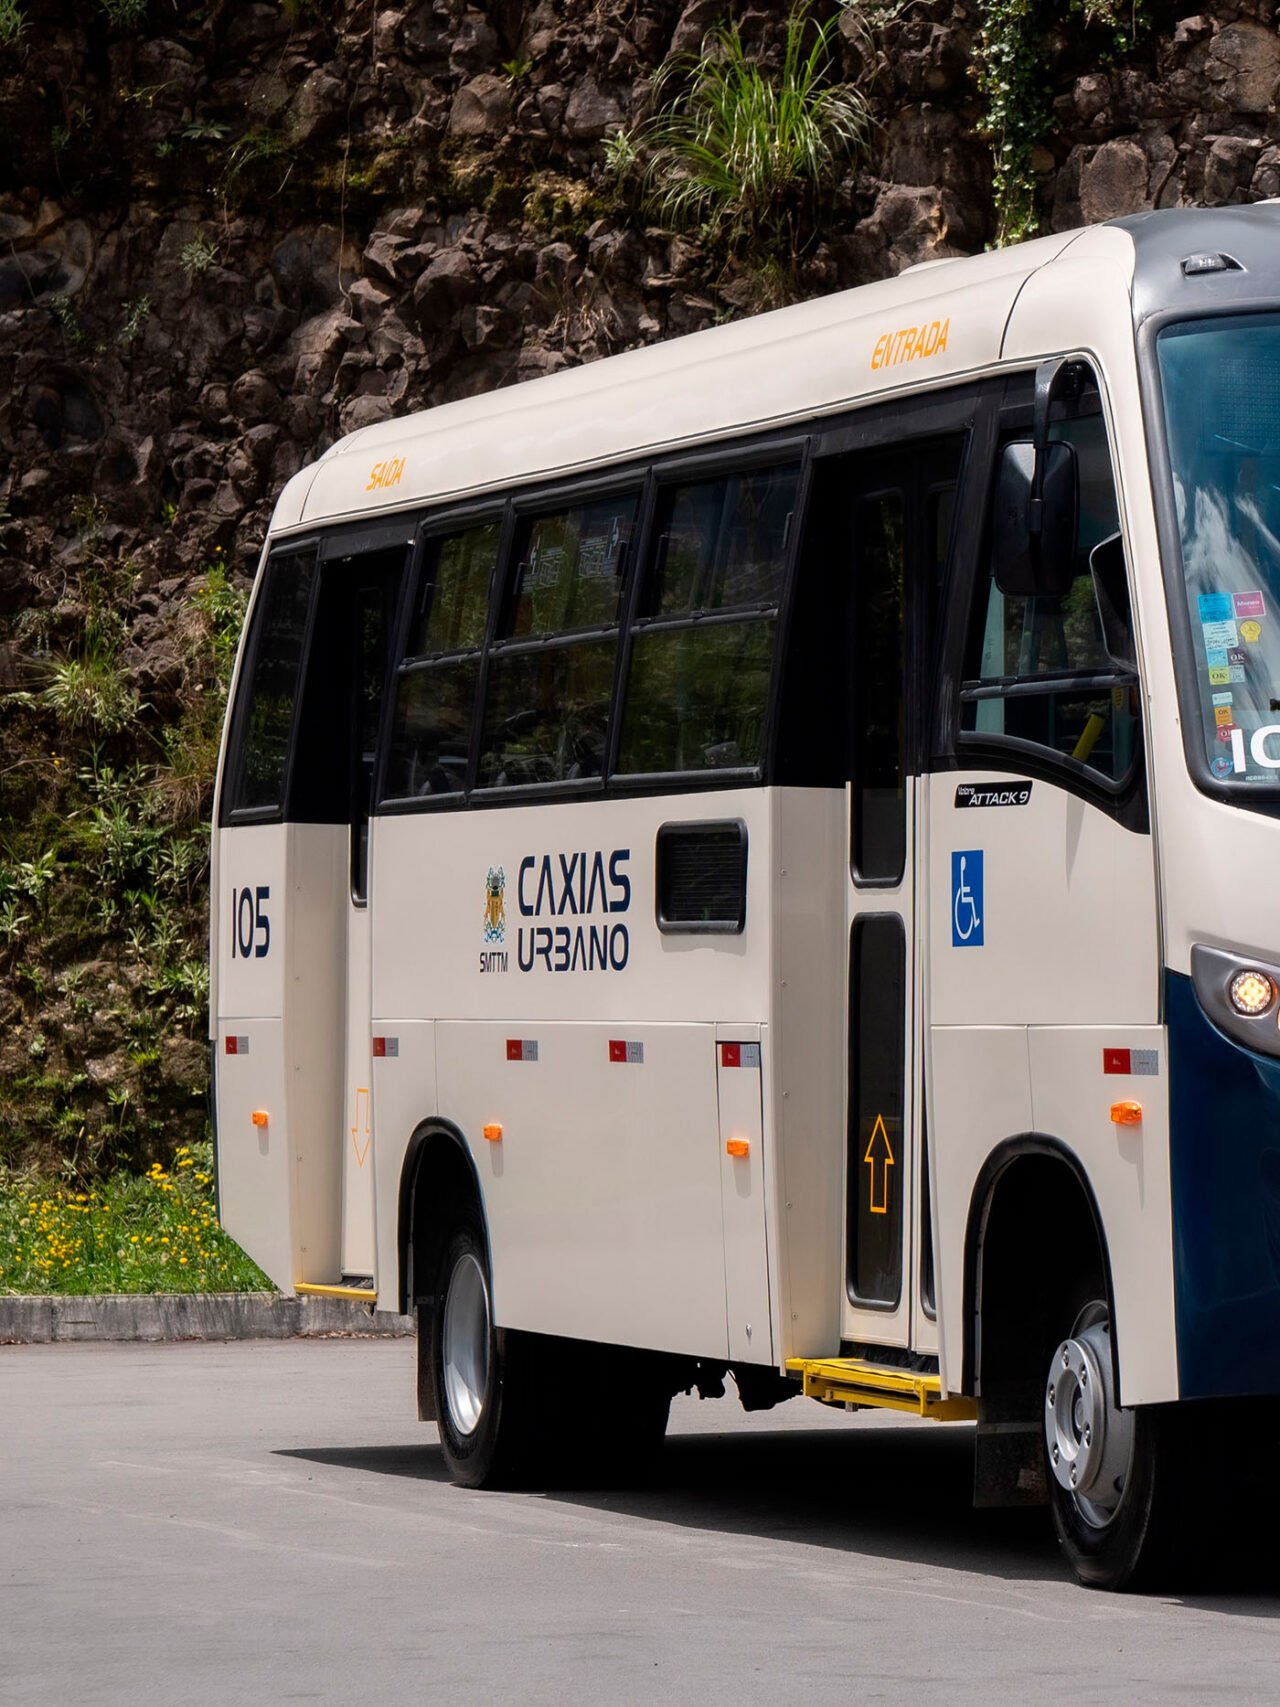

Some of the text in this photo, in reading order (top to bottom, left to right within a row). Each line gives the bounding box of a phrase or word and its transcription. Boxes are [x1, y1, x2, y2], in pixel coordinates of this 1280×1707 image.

[871, 318, 951, 370] ENTRADA
[366, 457, 404, 491] SAÍDA
[969, 791, 1029, 805] ATTACK 9
[519, 849, 630, 916] CAXIAS
[232, 886, 270, 959] 105
[480, 952, 508, 973] SMTTM
[518, 923, 629, 972] URBANO
